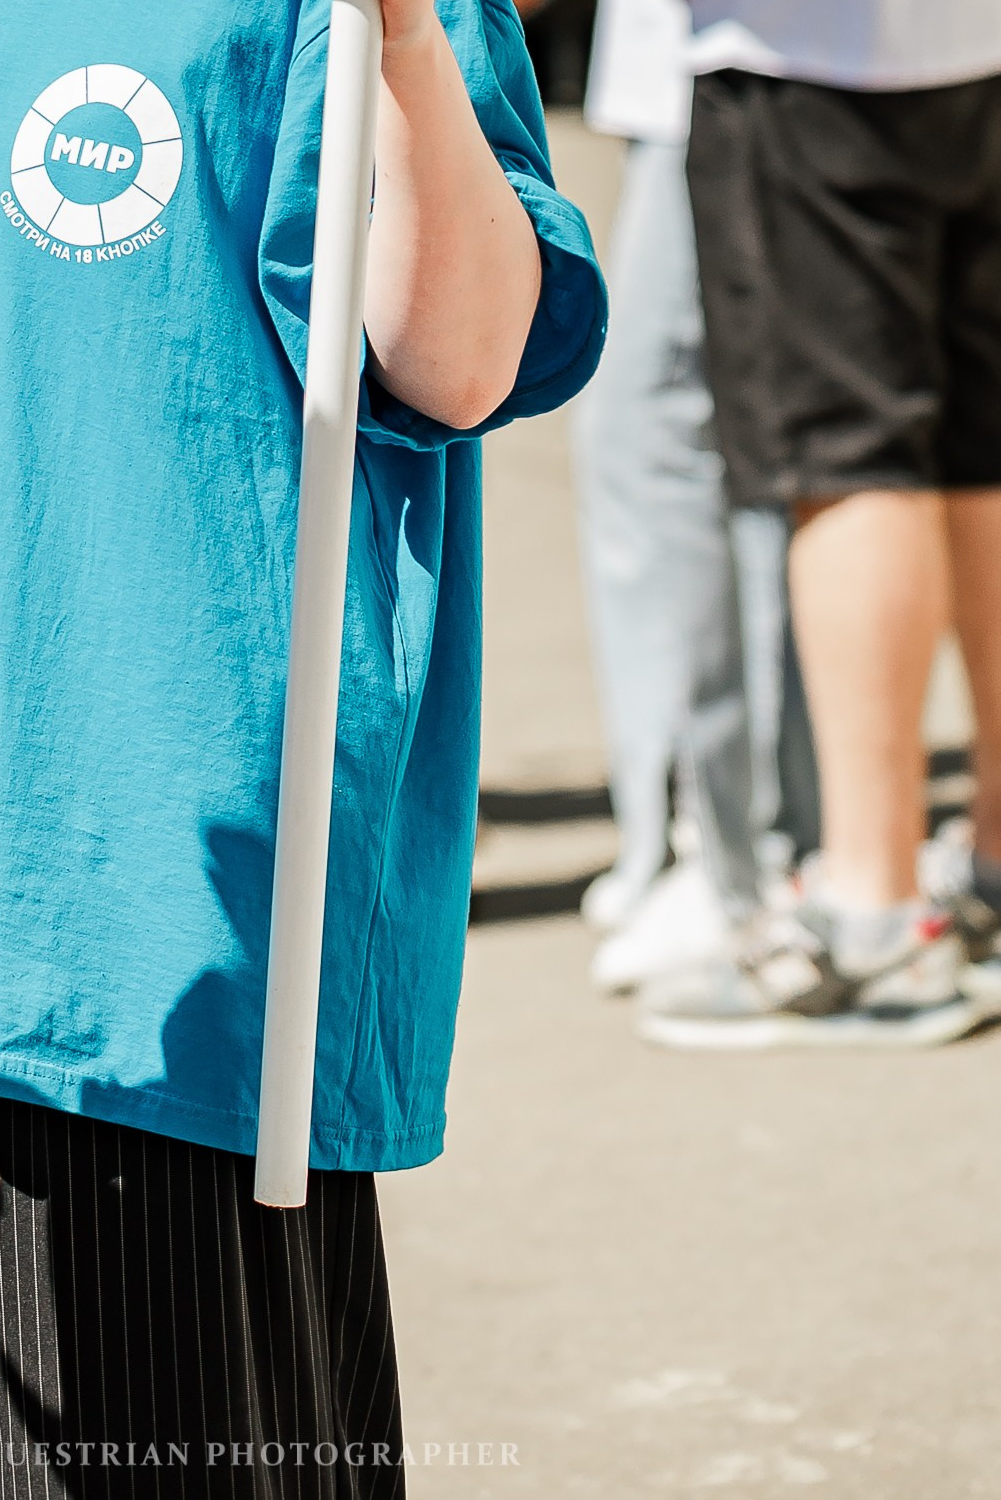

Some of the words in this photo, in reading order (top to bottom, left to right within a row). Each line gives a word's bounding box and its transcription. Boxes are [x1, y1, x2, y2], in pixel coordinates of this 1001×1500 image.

[50, 132, 135, 174] МИР
[0, 190, 50, 251] СМОТРИ
[50, 244, 71, 262] НА
[74, 248, 93, 263] 18
[96, 220, 167, 262] КНОПКЕ
